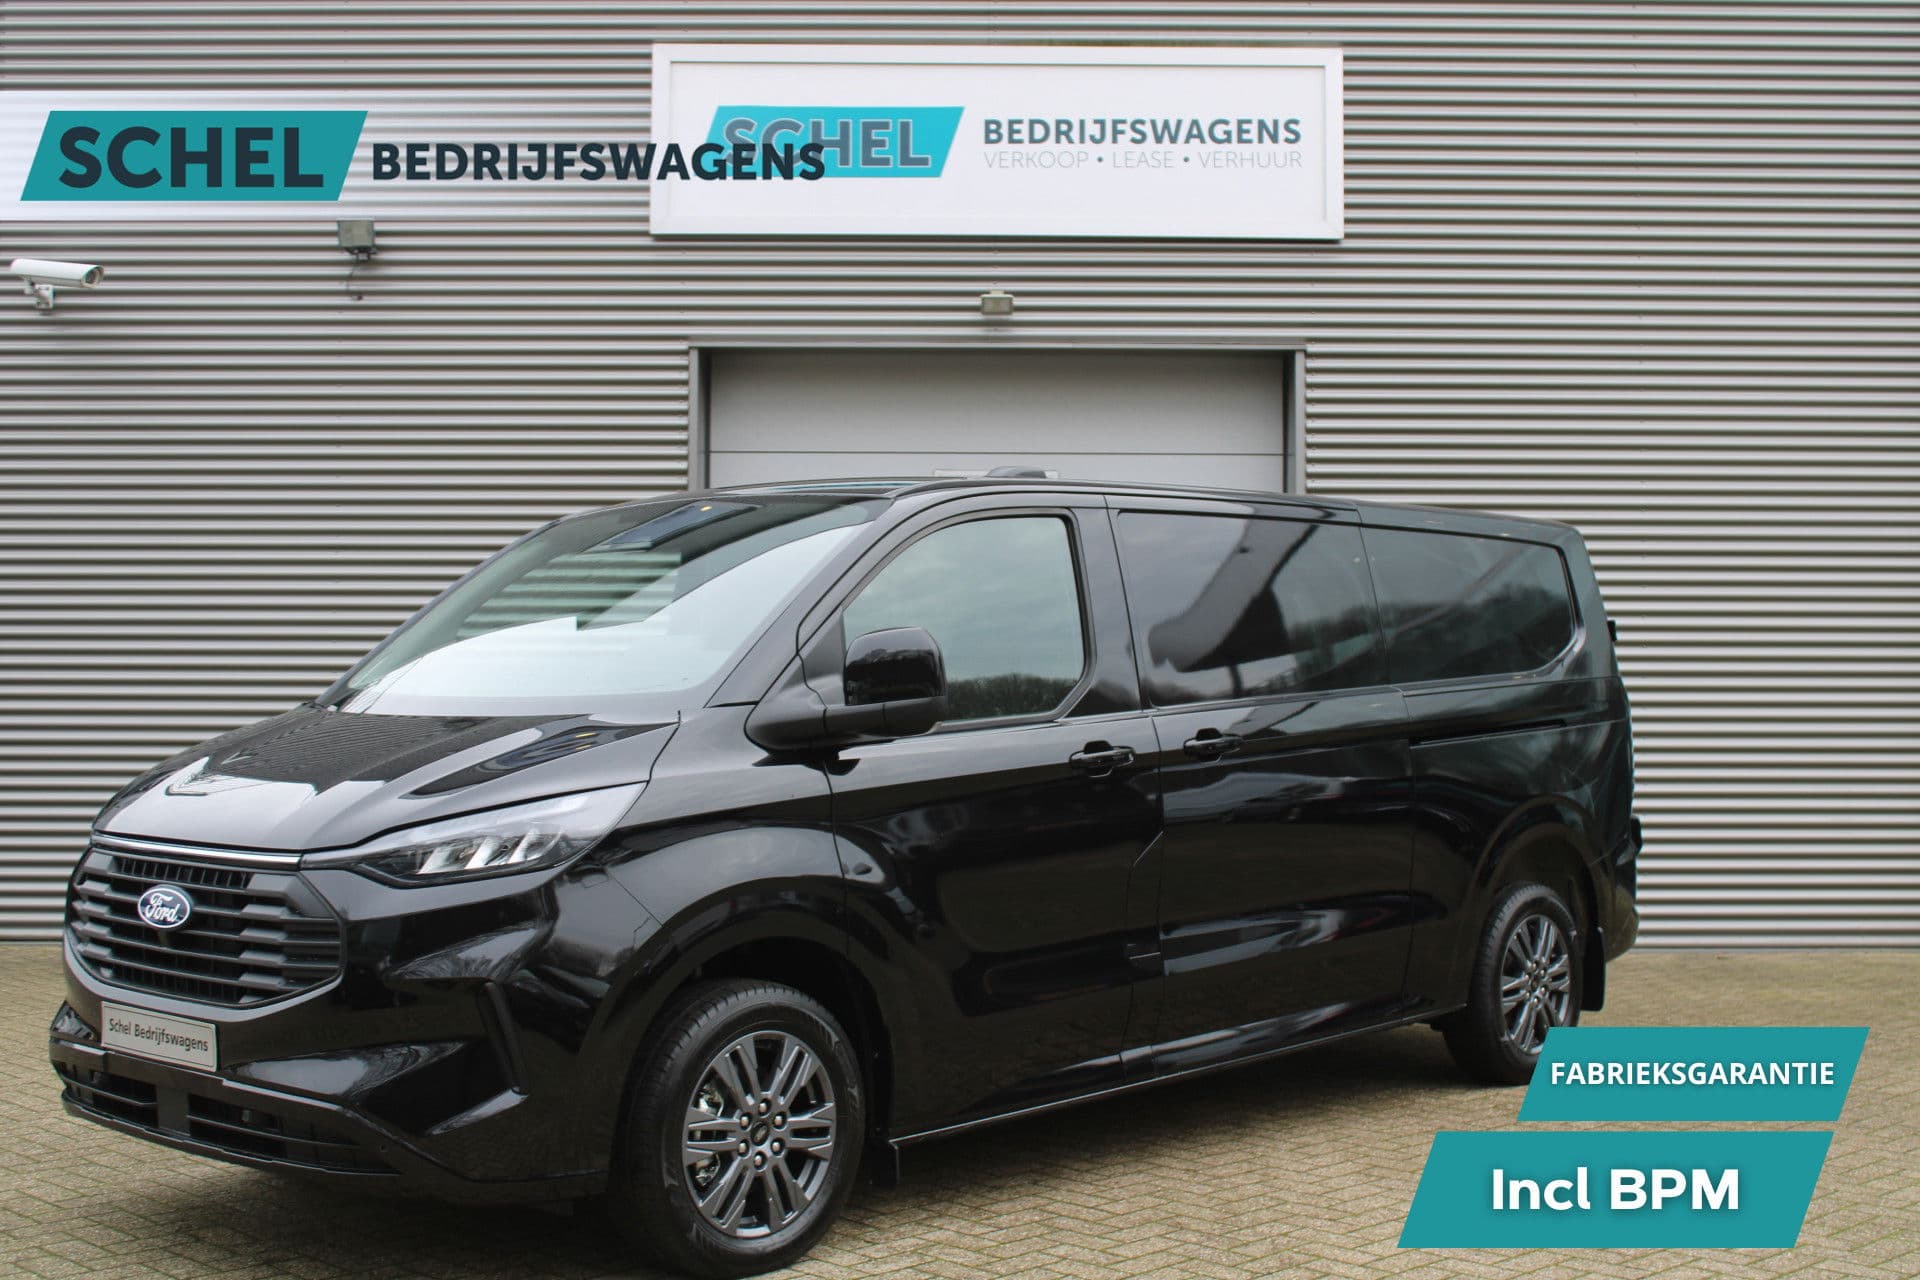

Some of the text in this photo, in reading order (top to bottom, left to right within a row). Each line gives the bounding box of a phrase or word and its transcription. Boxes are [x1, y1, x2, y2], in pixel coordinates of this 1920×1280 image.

[983, 118, 1302, 144] BEDRIJFSWAGENS
[984, 151, 1302, 169] VERKOOP LEASE VERHUUR
[145, 892, 181, 922] Ford
[109, 1018, 208, 1051] Schel Bedrijfswagens
